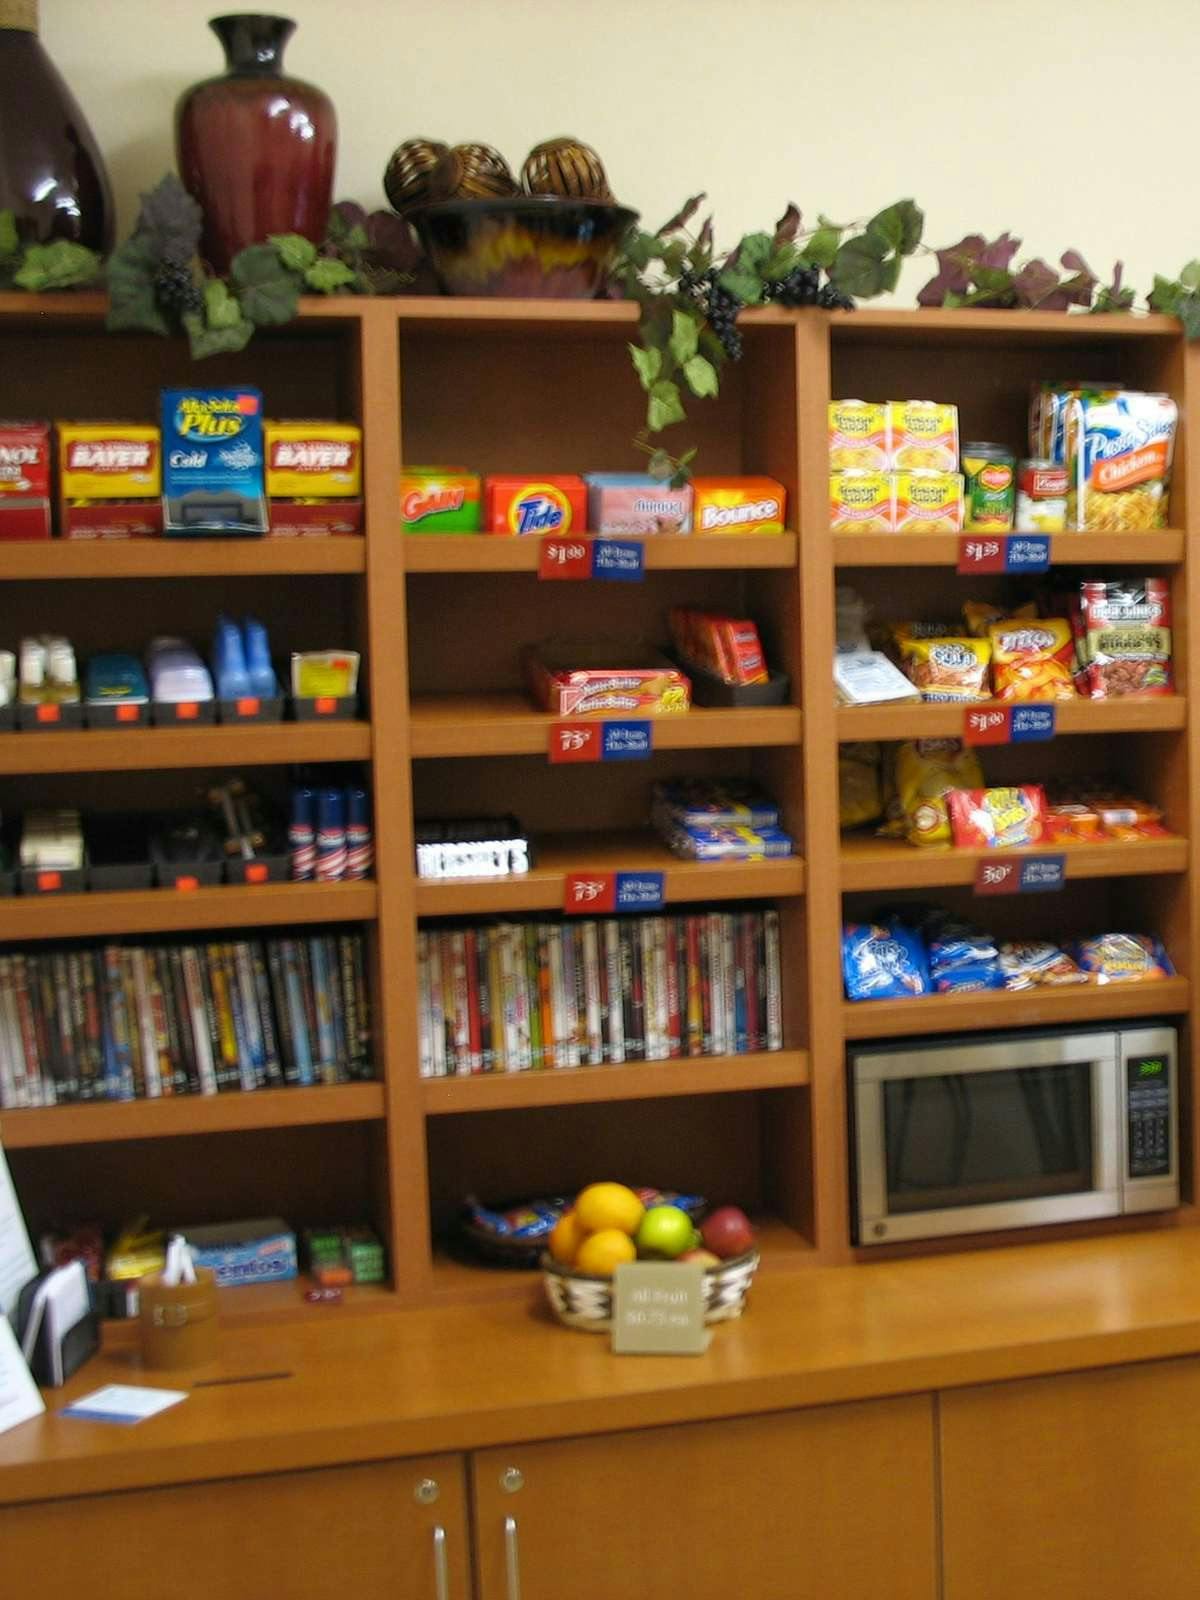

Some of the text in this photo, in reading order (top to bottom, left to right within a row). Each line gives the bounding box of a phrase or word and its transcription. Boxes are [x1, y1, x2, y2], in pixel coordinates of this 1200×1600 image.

[180, 413, 242, 436] Plus
[70, 449, 149, 467] BAYER
[274, 449, 351, 467] BAYER
[519, 498, 563, 535] Tide
[702, 501, 778, 527] Bounce
